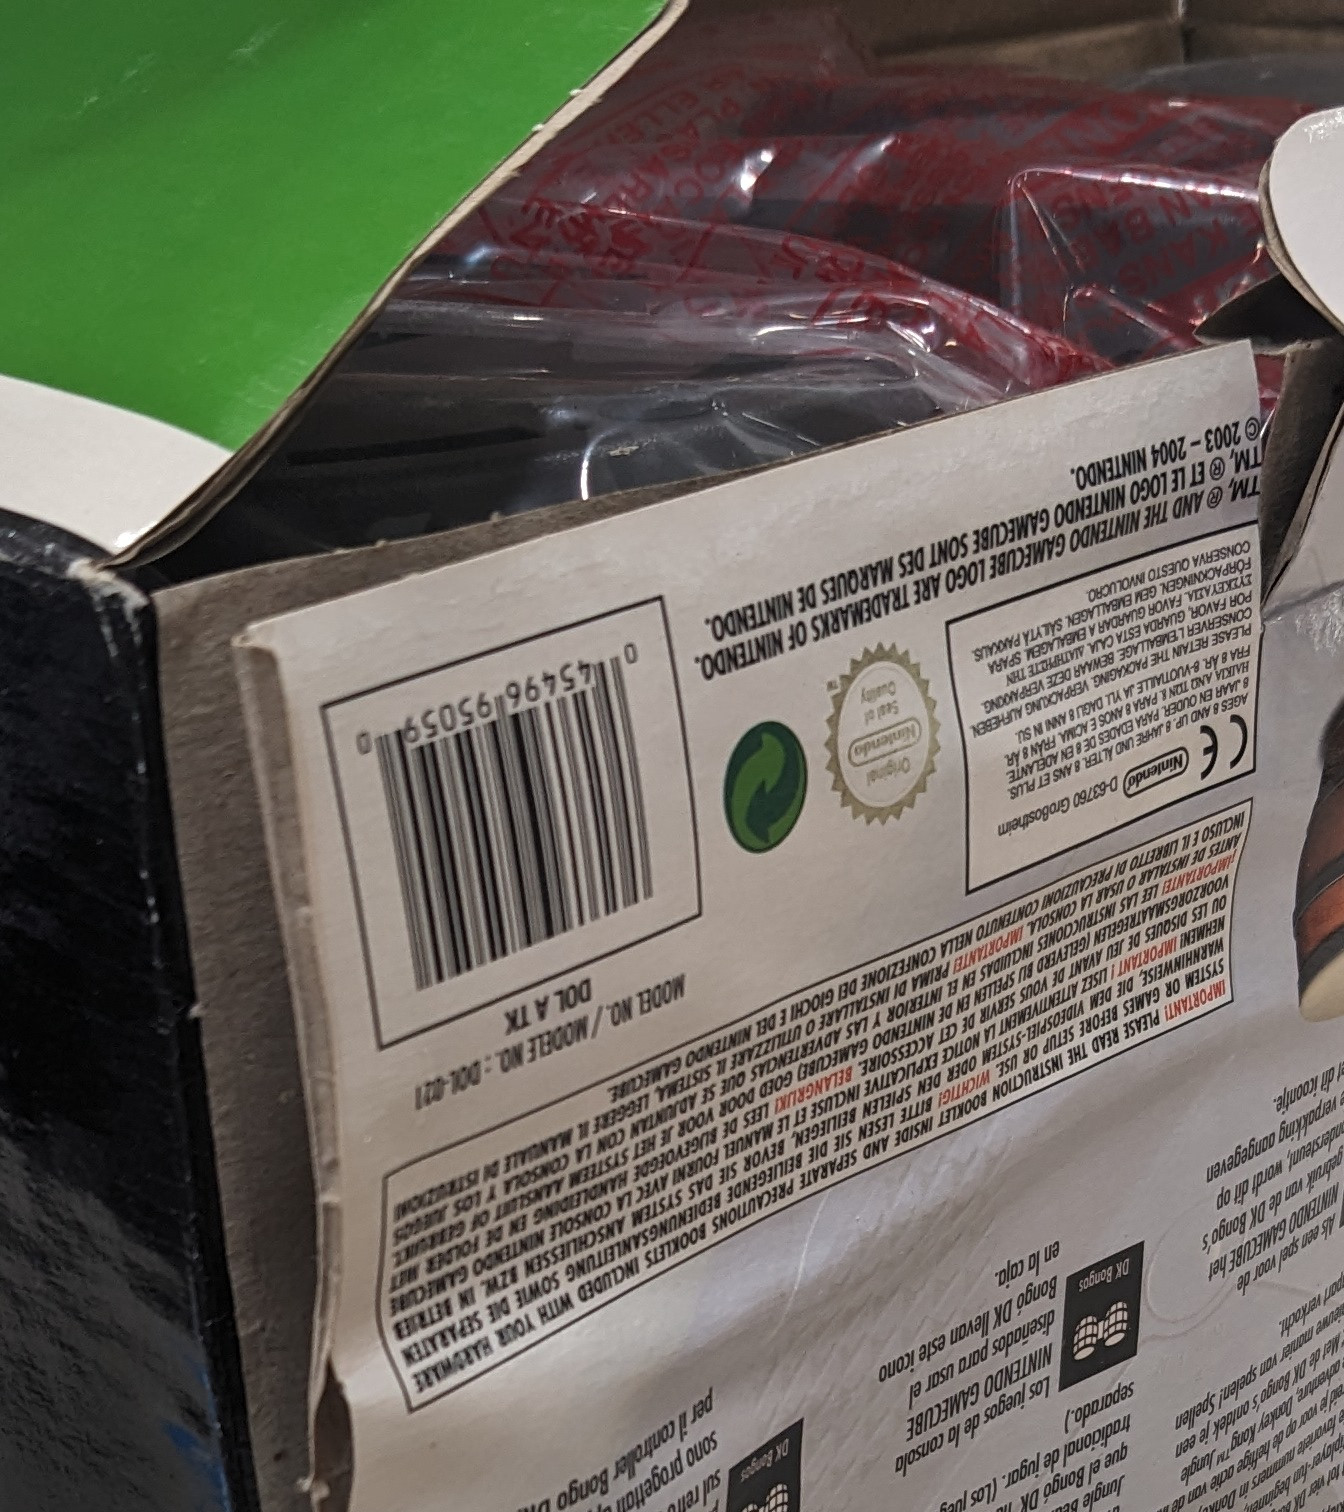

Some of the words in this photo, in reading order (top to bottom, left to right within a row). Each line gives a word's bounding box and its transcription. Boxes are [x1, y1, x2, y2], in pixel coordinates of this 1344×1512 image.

[1150, 435, 1187, 469] 2004
[1203, 420, 1242, 453] 2003
[1069, 446, 1147, 491] NINTENDO.
[1170, 465, 1186, 493] LE
[1188, 460, 1205, 488] ET
[1128, 470, 1167, 505] LOGO
[1171, 489, 1205, 520] AND
[1053, 483, 1126, 529] NINTENDO
[1142, 499, 1168, 530] THE
[972, 507, 1050, 555] GAMECUBE
[1068, 508, 1141, 553] NINTENDO
[896, 545, 925, 579] DES
[928, 532, 968, 569] SONT
[988, 532, 1066, 579] GAMECUBE
[819, 556, 893, 605] MARQUES
[912, 571, 941, 605] ARE
[944, 557, 985, 594] LOGO
[796, 582, 816, 613] DE
[810, 583, 910, 642] TRADEMARKS
[704, 590, 794, 642] NINTENDO.
[787, 619, 807, 651] OF
[1171, 635, 1209, 659] RETAIN
[1210, 621, 1252, 647] PLEASE
[694, 628, 784, 680] NINTENDO.
[1149, 648, 1169, 667] THE
[504, 659, 593, 708] 45496
[1090, 655, 1149, 688] PACKAGING.
[403, 691, 493, 744] 95059
[1072, 774, 1118, 808] D-63760
[534, 995, 549, 1021] A
[553, 977, 592, 1012] DOL
[609, 995, 633, 1027] NO.
[635, 973, 685, 1015] MODEL
[1163, 978, 1226, 1022] IMPORTANT!
[504, 1004, 530, 1035] TK
[1121, 1007, 1160, 1040] PLEASE
[527, 1015, 588, 1063] MODELE
[1066, 1041, 1088, 1066] THE
[1090, 1026, 1119, 1053] READ
[991, 1052, 1064, 1102] INSTRUCTION
[936, 1089, 987, 1128] BOOKLET
[862, 1134, 890, 1160] AND
[893, 1115, 934, 1147] INSIDE
[798, 1147, 857, 1190] SEPARATE
[711, 1177, 794, 1234] PRECAUTIONS
[1300, 1223, 1320, 1249] een
[1320, 1211, 1336, 1241] Als
[643, 1221, 706, 1269] BOOKLETS
[1043, 1239, 1060, 1263] en
[1276, 1234, 1300, 1273] spel
[576, 1255, 640, 1302] INCLUDED
[993, 1258, 1024, 1287] caja.
[1027, 1249, 1040, 1277] la
[1077, 1264, 1113, 1292] Bongos
[1114, 1257, 1130, 1280] DK
[1251, 1253, 1276, 1282] voor
[1015, 1274, 1058, 1316] Bongó
[1235, 1269, 1251, 1297] de
[536, 1291, 572, 1325] WITH
[991, 1297, 1013, 1330] DK
[494, 1313, 534, 1347] YOUR
[949, 1309, 990, 1346] llevan
[991, 1308, 1055, 1359] diseñados
[917, 1333, 946, 1362] este
[957, 1336, 989, 1375] para
[877, 1348, 915, 1383] icono
[923, 1362, 954, 1393] usar
[982, 1341, 1053, 1398] NINTENDO
[907, 1379, 922, 1410] el
[982, 1381, 1026, 1424] juegos
[1027, 1374, 1050, 1400] Los
[905, 1380, 980, 1442] GAMECUBE
[963, 1412, 980, 1440] de
[946, 1422, 961, 1448] la
[894, 1432, 944, 1478] consola
